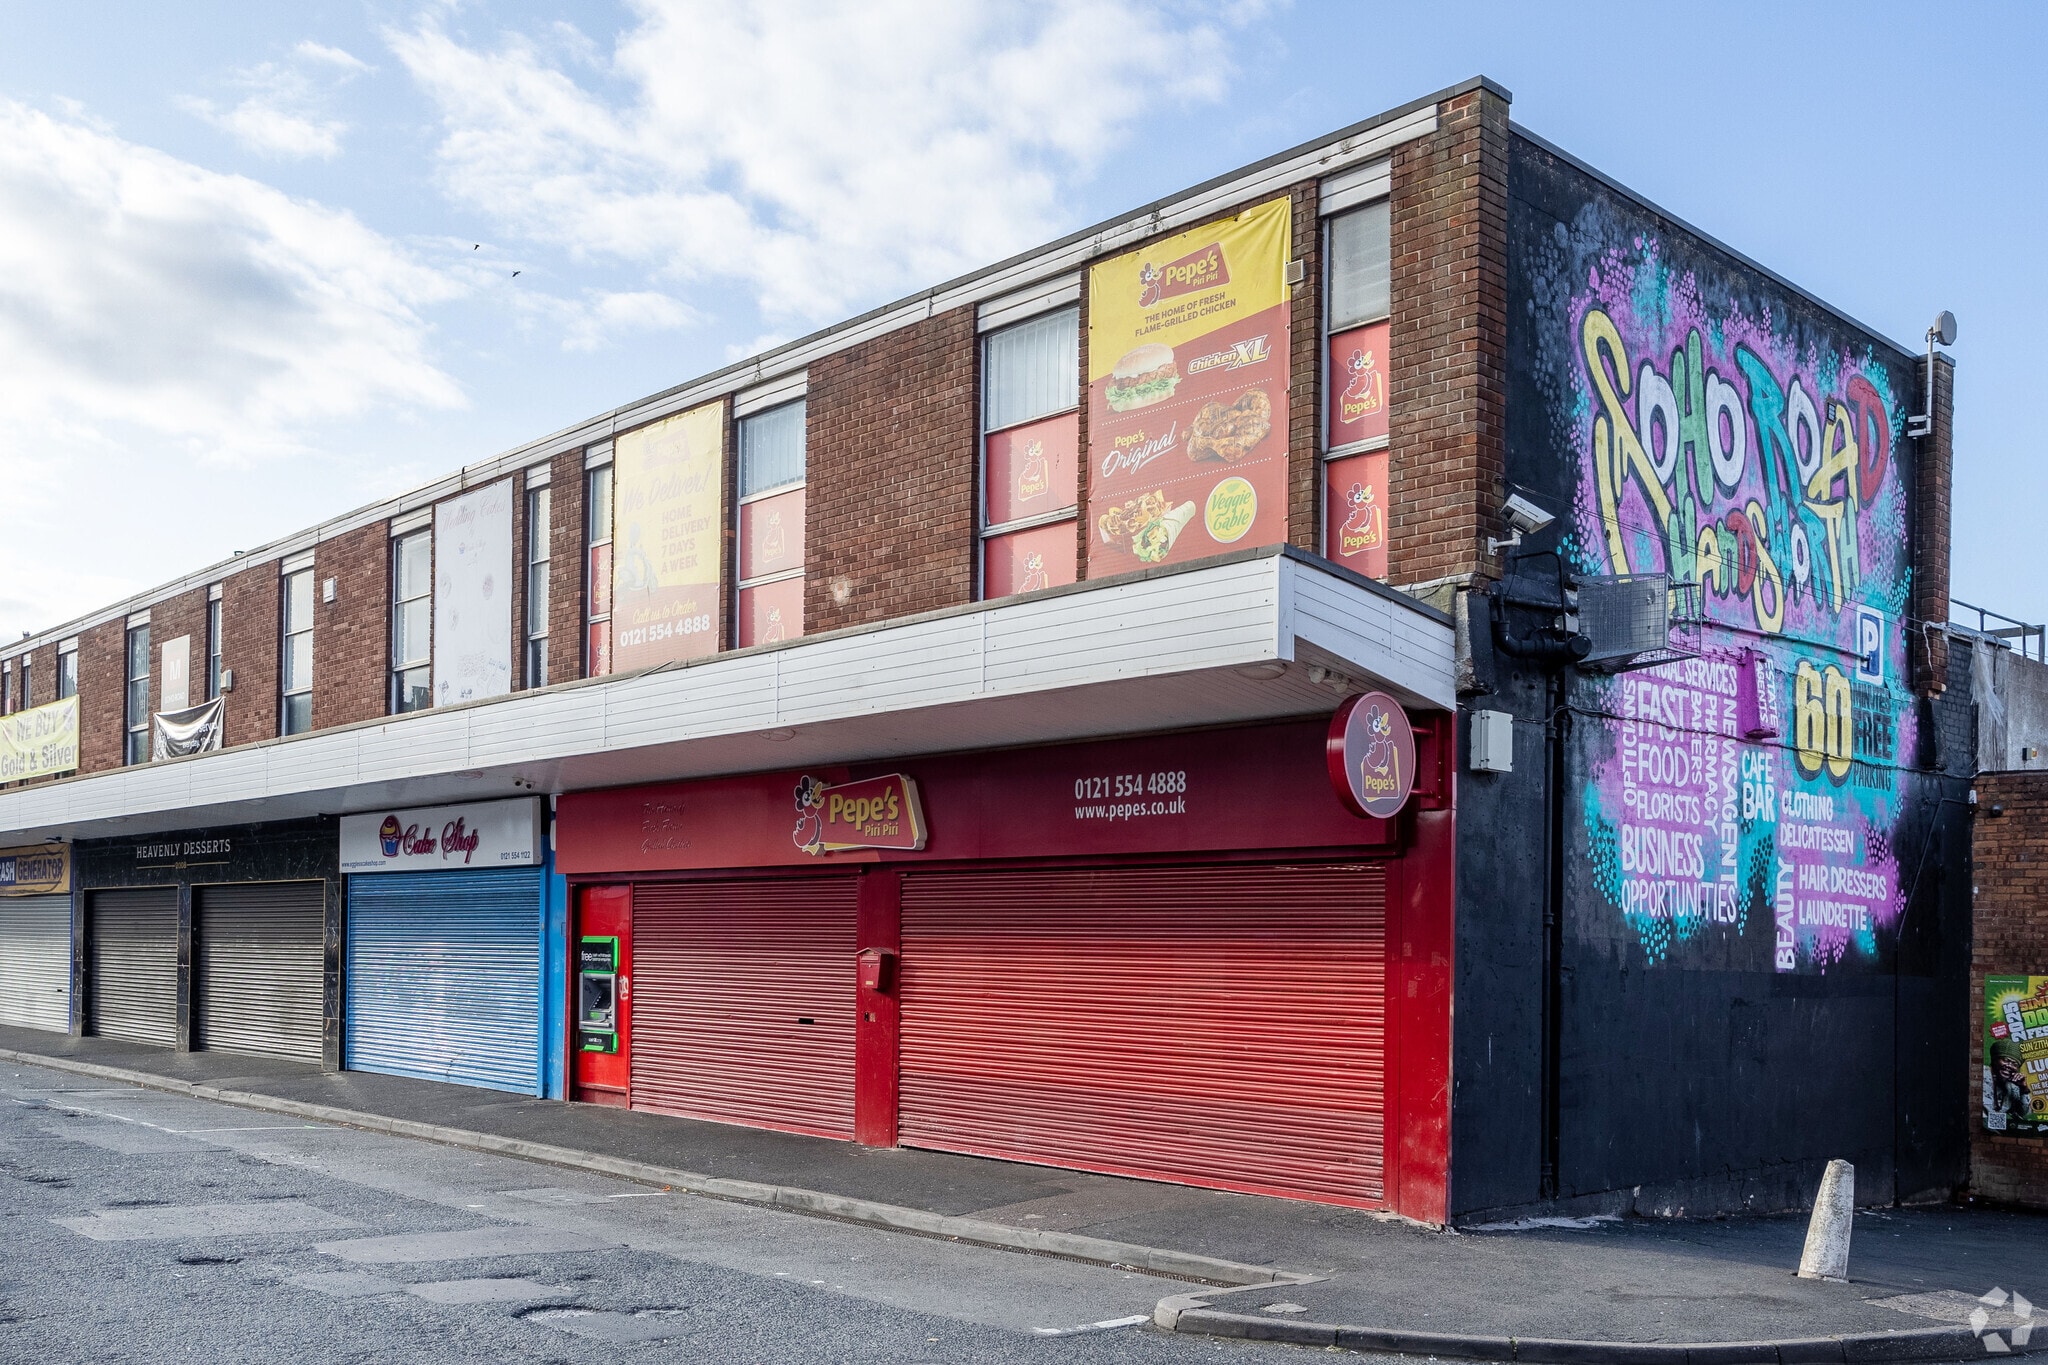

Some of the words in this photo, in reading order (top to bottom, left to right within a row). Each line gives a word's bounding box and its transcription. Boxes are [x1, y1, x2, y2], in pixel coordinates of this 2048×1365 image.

[1165, 250, 1219, 286] Pepe's
[1193, 276, 1205, 287] Piri
[1206, 270, 1218, 282] Piri
[1135, 311, 1199, 337] FLAME-GRILLED
[1199, 298, 1237, 316] CHICKEN
[1145, 312, 1160, 324] THE
[1161, 304, 1186, 317] HOME
[1186, 300, 1198, 311] OF
[1199, 291, 1226, 307] FRESH
[1344, 395, 1377, 415] Pepe's
[1114, 428, 1145, 448] Pepe's
[1734, 343, 1890, 512] ROAD
[1101, 420, 1177, 478] Original
[622, 486, 644, 515] We
[649, 462, 713, 506] Deliver!
[1020, 479, 1045, 494] Pepe's
[1211, 490, 1251, 517] Veggie
[661, 504, 692, 524] HOME
[662, 515, 711, 541] DELIVERY
[1213, 508, 1250, 531] Table
[661, 545, 668, 559] 7
[669, 538, 696, 558] DAYS
[1343, 530, 1377, 549] Pepe's
[661, 561, 668, 576] A
[669, 554, 699, 573] WEEK
[632, 607, 651, 625] Call
[650, 610, 661, 621] us
[662, 604, 670, 618] to
[672, 598, 698, 617] Order
[620, 627, 646, 648] 0121
[649, 621, 673, 642] 554
[675, 614, 711, 636] 4888
[1685, 658, 1738, 698] SERVICES
[1756, 660, 1769, 724] AGENTS
[1765, 658, 1779, 729] ESTATE
[17, 716, 32, 742] WE
[36, 709, 59, 738] BUY
[1638, 681, 1690, 743] FAST
[1793, 659, 1853, 784] 60
[1622, 679, 1638, 807] OPTICIANS
[1690, 690, 1703, 784] BAKERS
[1852, 709, 1893, 760] FREE
[1, 751, 25, 777] Gold
[30, 749, 37, 771] &
[42, 743, 77, 769] Silver
[1638, 742, 1690, 788] FOOD
[1704, 694, 1718, 836] PHARMACY
[1742, 749, 1774, 783] CAFE
[1853, 762, 1892, 792] PARKING
[1075, 776, 1110, 800] 0121
[1114, 774, 1143, 797] 554
[1147, 770, 1187, 795] 4888
[1365, 774, 1395, 794] Pepe's
[829, 785, 899, 831] Pepe's
[1075, 796, 1186, 821] www.pepes.co.uk
[1637, 790, 1701, 825] FLORISTS
[1743, 781, 1775, 822] BAR
[1782, 791, 1833, 822] CLOTHING
[400, 823, 438, 857] Cake
[441, 816, 480, 865] Shop
[865, 823, 881, 837] Piri
[882, 822, 899, 836] Piri
[1780, 822, 1854, 854] DELICATESSEN
[136, 843, 180, 859] HEAVENLY
[183, 839, 231, 855] DESSERTS
[1621, 823, 1705, 879] BUSINESS
[0, 862, 16, 882] ASH
[17, 857, 63, 881] GENERATOR
[1799, 864, 1829, 893] HAIR
[1830, 866, 1887, 901] DRESSERS
[1621, 879, 1737, 923] OPPORTUNITIES
[1776, 856, 1795, 970] BEAUTY
[1799, 900, 1867, 931] LAUNDRETTE
[581, 950, 592, 961] free
[2003, 1001, 2028, 1043] 2025
[2020, 1042, 2034, 1053] SUN
